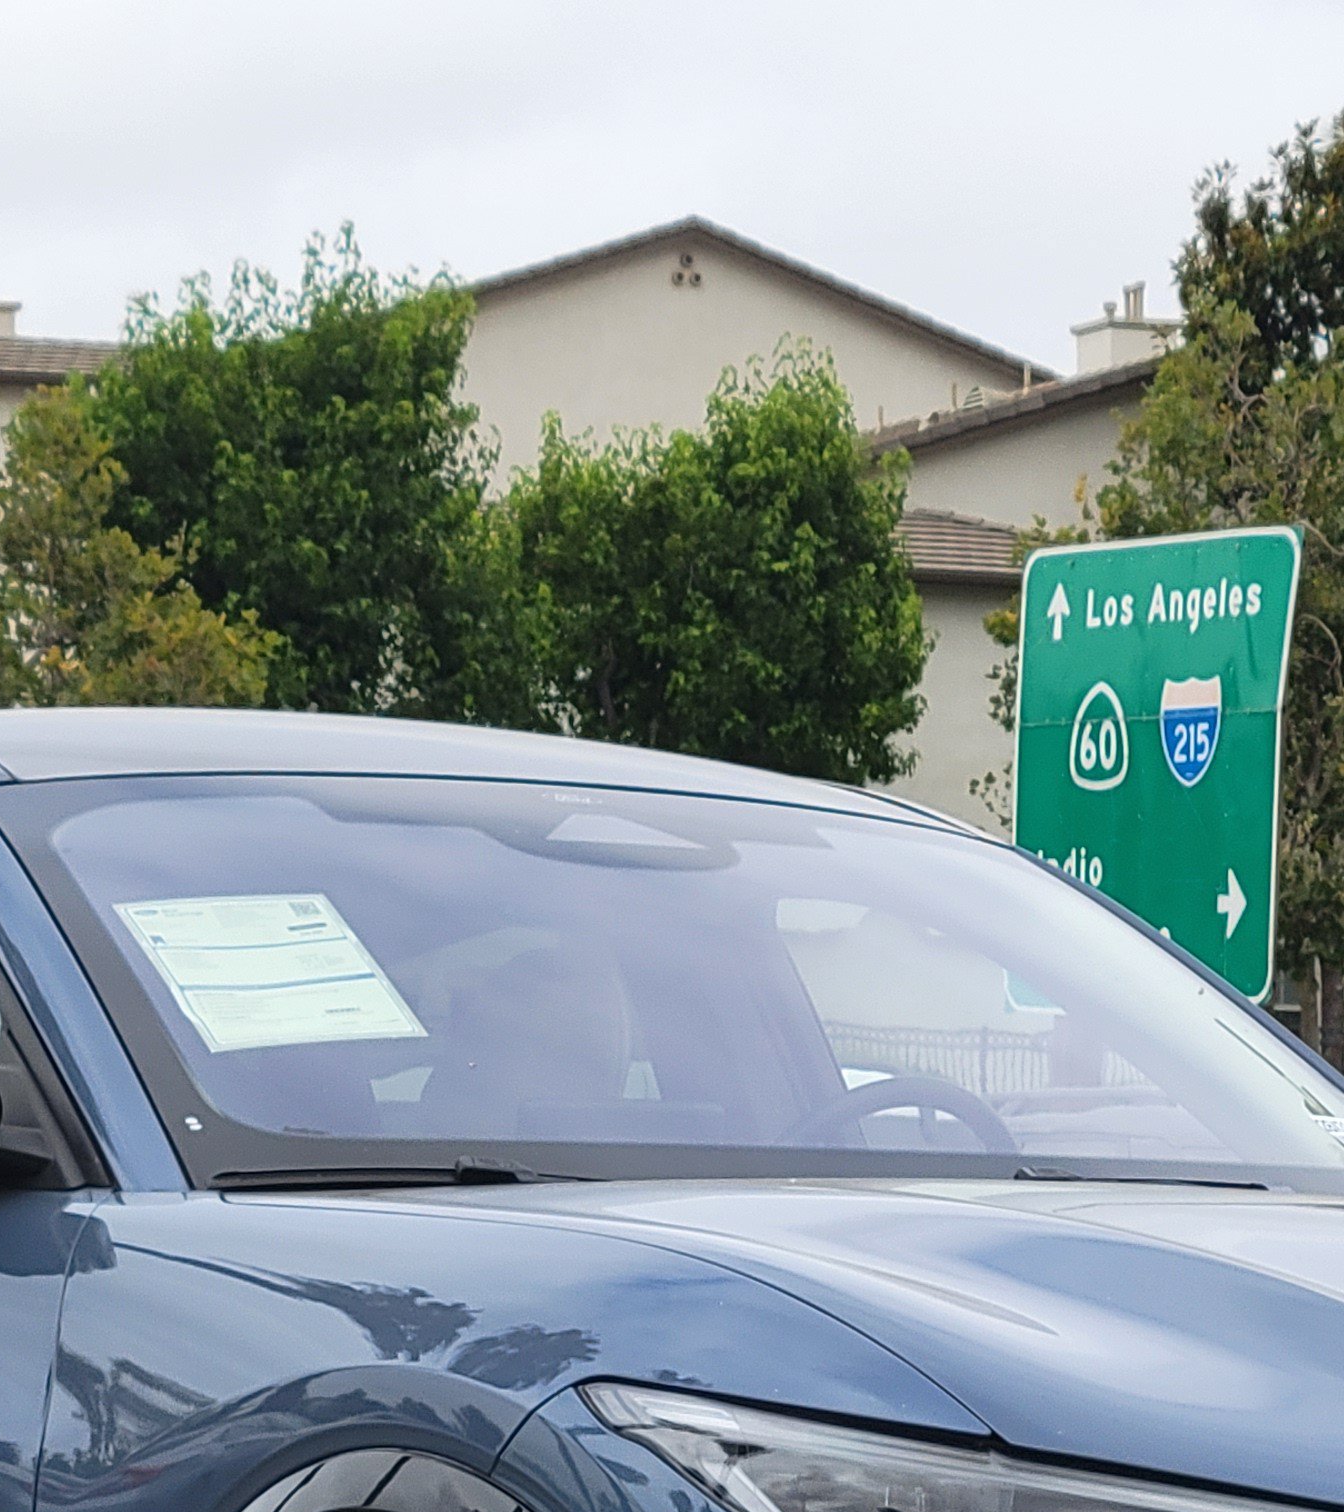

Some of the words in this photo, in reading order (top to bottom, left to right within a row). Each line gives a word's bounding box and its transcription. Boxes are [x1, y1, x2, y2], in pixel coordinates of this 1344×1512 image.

[1086, 588, 1134, 628] Los
[1147, 577, 1262, 634] Angeles
[1079, 719, 1117, 771] 60
[1173, 722, 1210, 763] 215
[1038, 847, 1103, 887] dio
